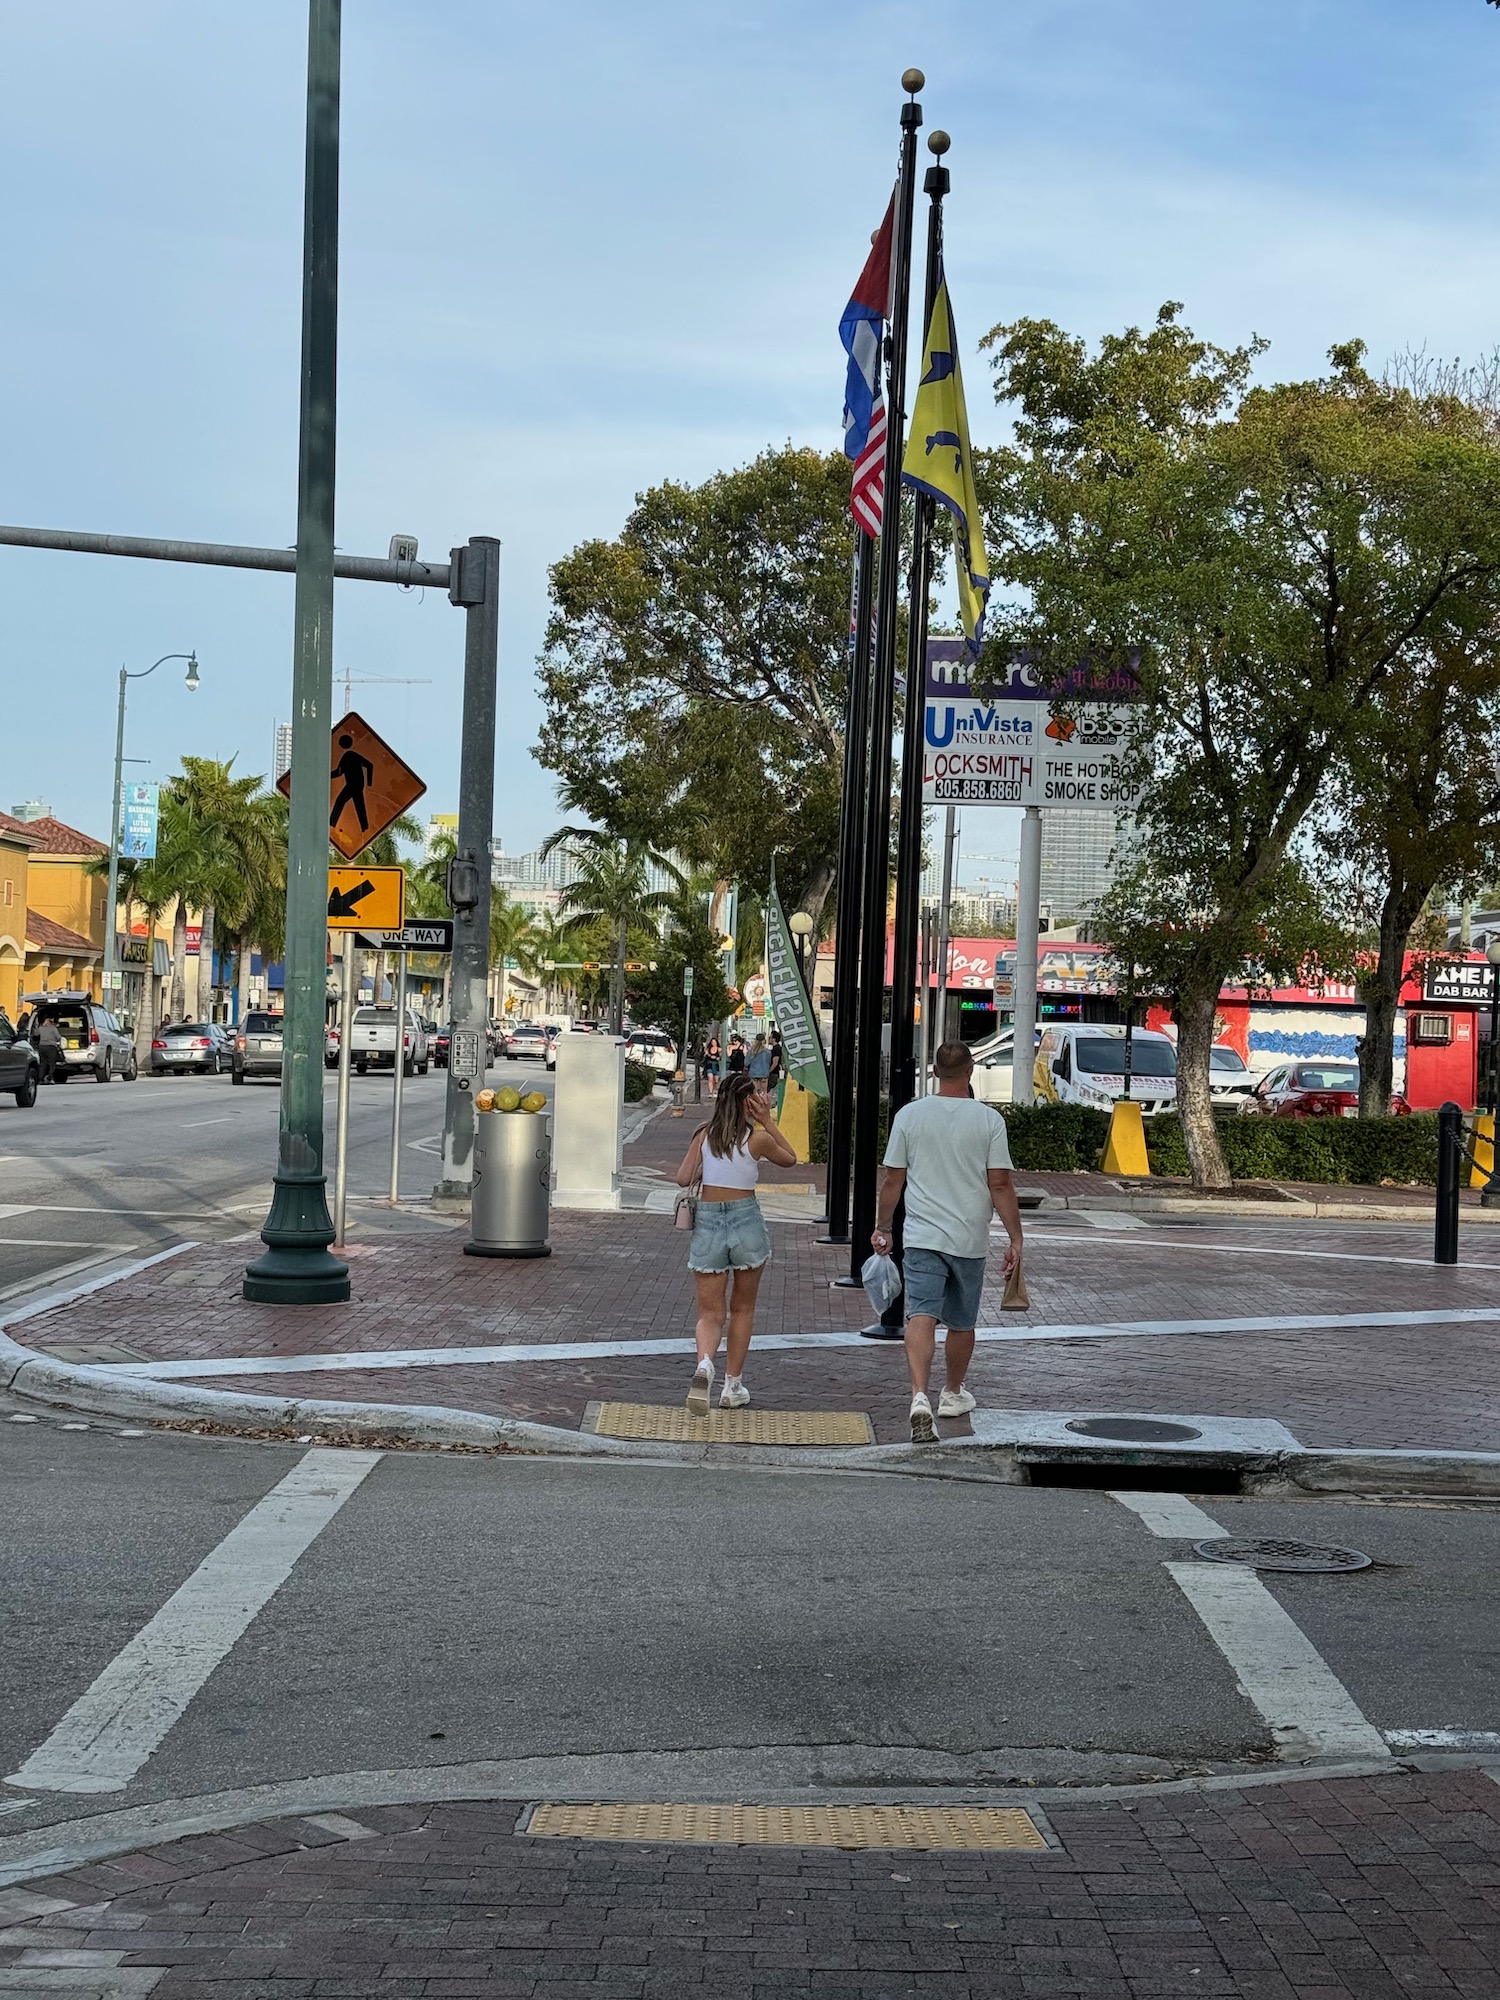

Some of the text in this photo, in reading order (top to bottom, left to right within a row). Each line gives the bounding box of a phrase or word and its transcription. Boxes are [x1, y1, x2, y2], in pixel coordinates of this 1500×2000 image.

[931, 660, 1043, 687] mro
[925, 706, 1033, 748] UniVista
[1079, 716, 1150, 736] boost
[956, 732, 1033, 746] INSURANCE
[1081, 735, 1117, 745] mobile
[923, 754, 1033, 787] LOCKSMITH
[1045, 761, 1073, 777] THE
[1077, 763, 1107, 778] HOT
[936, 778, 1021, 800] 305.858.6860
[1044, 781, 1140, 801] SMOKE SHOP
[414, 929, 443, 943] WAY
[1433, 985, 1489, 998] DAB BAR
